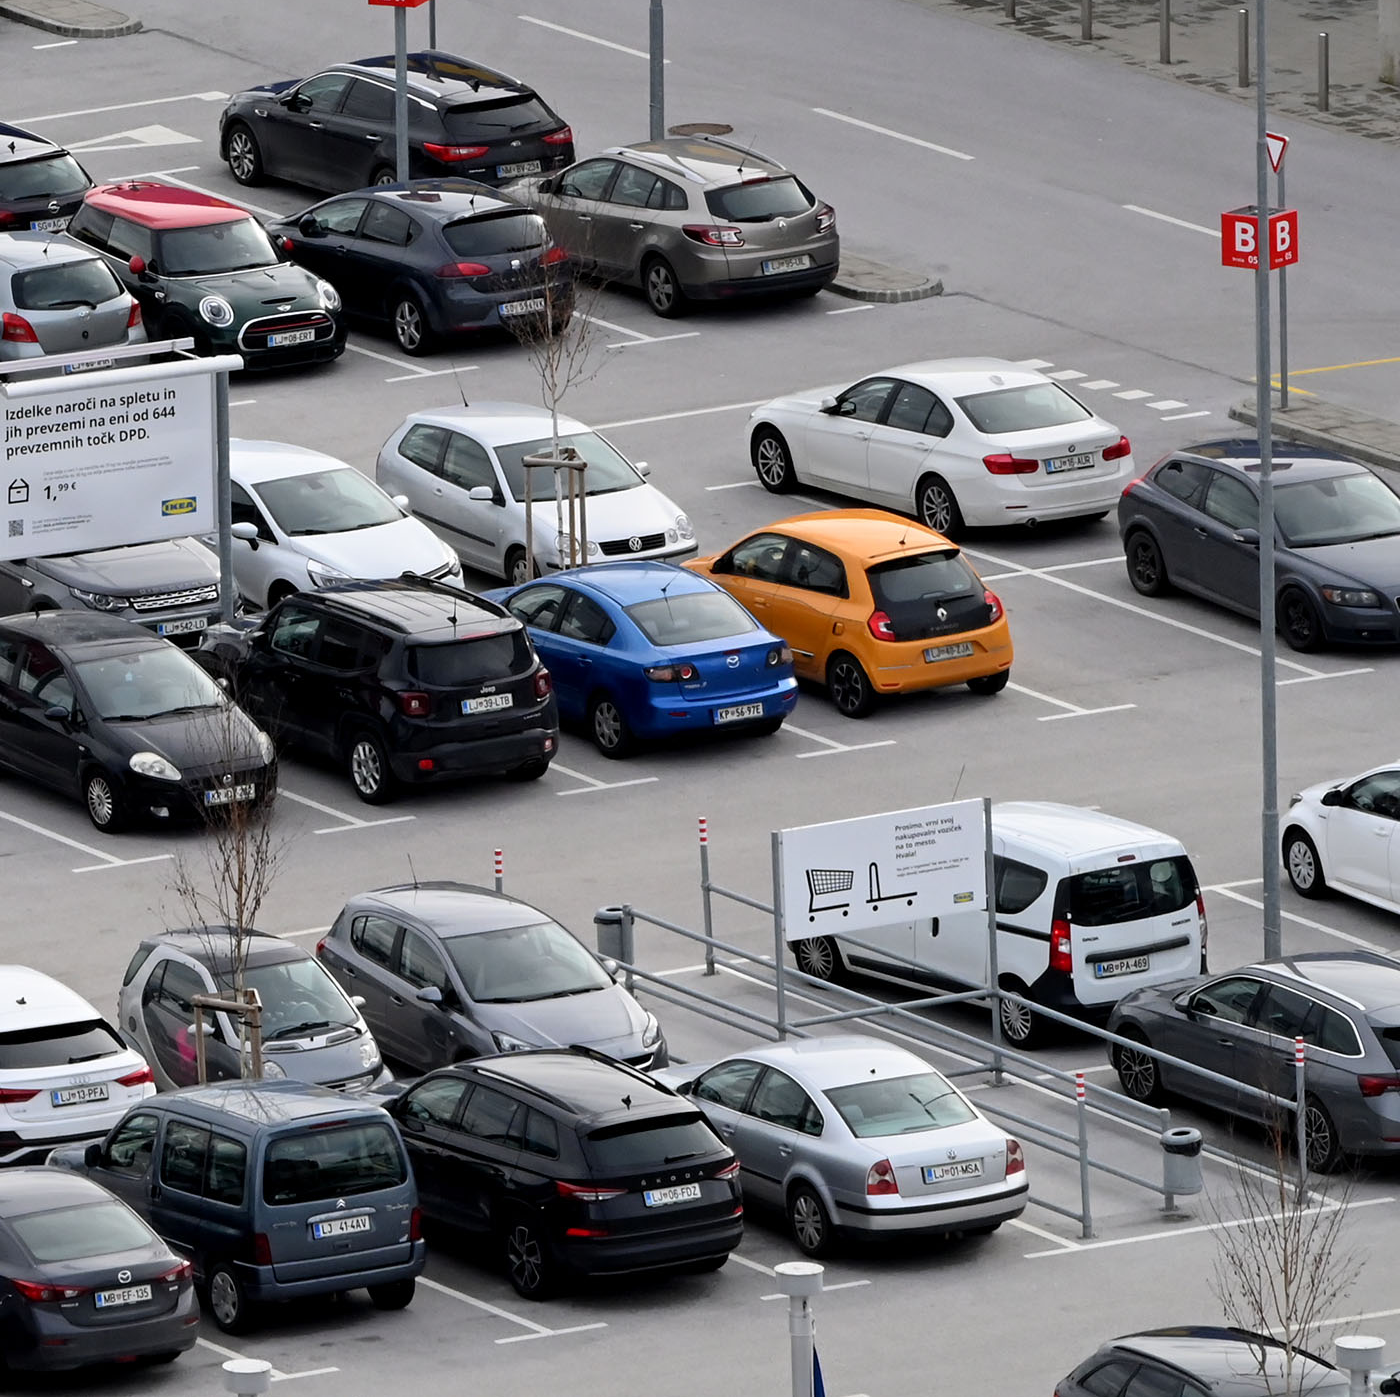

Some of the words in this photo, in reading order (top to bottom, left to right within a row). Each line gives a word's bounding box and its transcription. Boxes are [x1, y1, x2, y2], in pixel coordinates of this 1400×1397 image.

[1235, 221, 1256, 253] B
[1276, 220, 1290, 252] B
[1248, 255, 1258, 264] 05
[289, 333, 312, 342] 08-ERT
[6, 405, 52, 420] Izdelke
[56, 398, 96, 415] naroči
[100, 396, 116, 408] na
[120, 391, 160, 407] spletu
[164, 388, 176, 400] in
[5, 426, 22, 442] jih
[26, 417, 85, 441] prevzemi
[90, 417, 105, 428] na
[109, 411, 128, 425] eni
[133, 409, 148, 422] od
[153, 406, 176, 419] 644
[6, 436, 83, 460] prevzemnih
[87, 431, 115, 446] točk
[120, 428, 150, 442] DPD.
[44, 483, 69, 501] 1,99
[71, 481, 76, 490] €
[180, 621, 205, 631] 542-LD
[480, 686, 496, 694] Jeep
[484, 696, 510, 707] 39-LTB
[736, 706, 761, 717] 56-97E
[1120, 959, 1147, 971] PA-469
[77, 1088, 104, 1099] 13-PFA
[950, 1166, 979, 1176] 01-MSA
[670, 1188, 697, 1199] 06-FDZ
[340, 1217, 367, 1231] 41-4AV
[122, 1290, 148, 1301] EF-135
